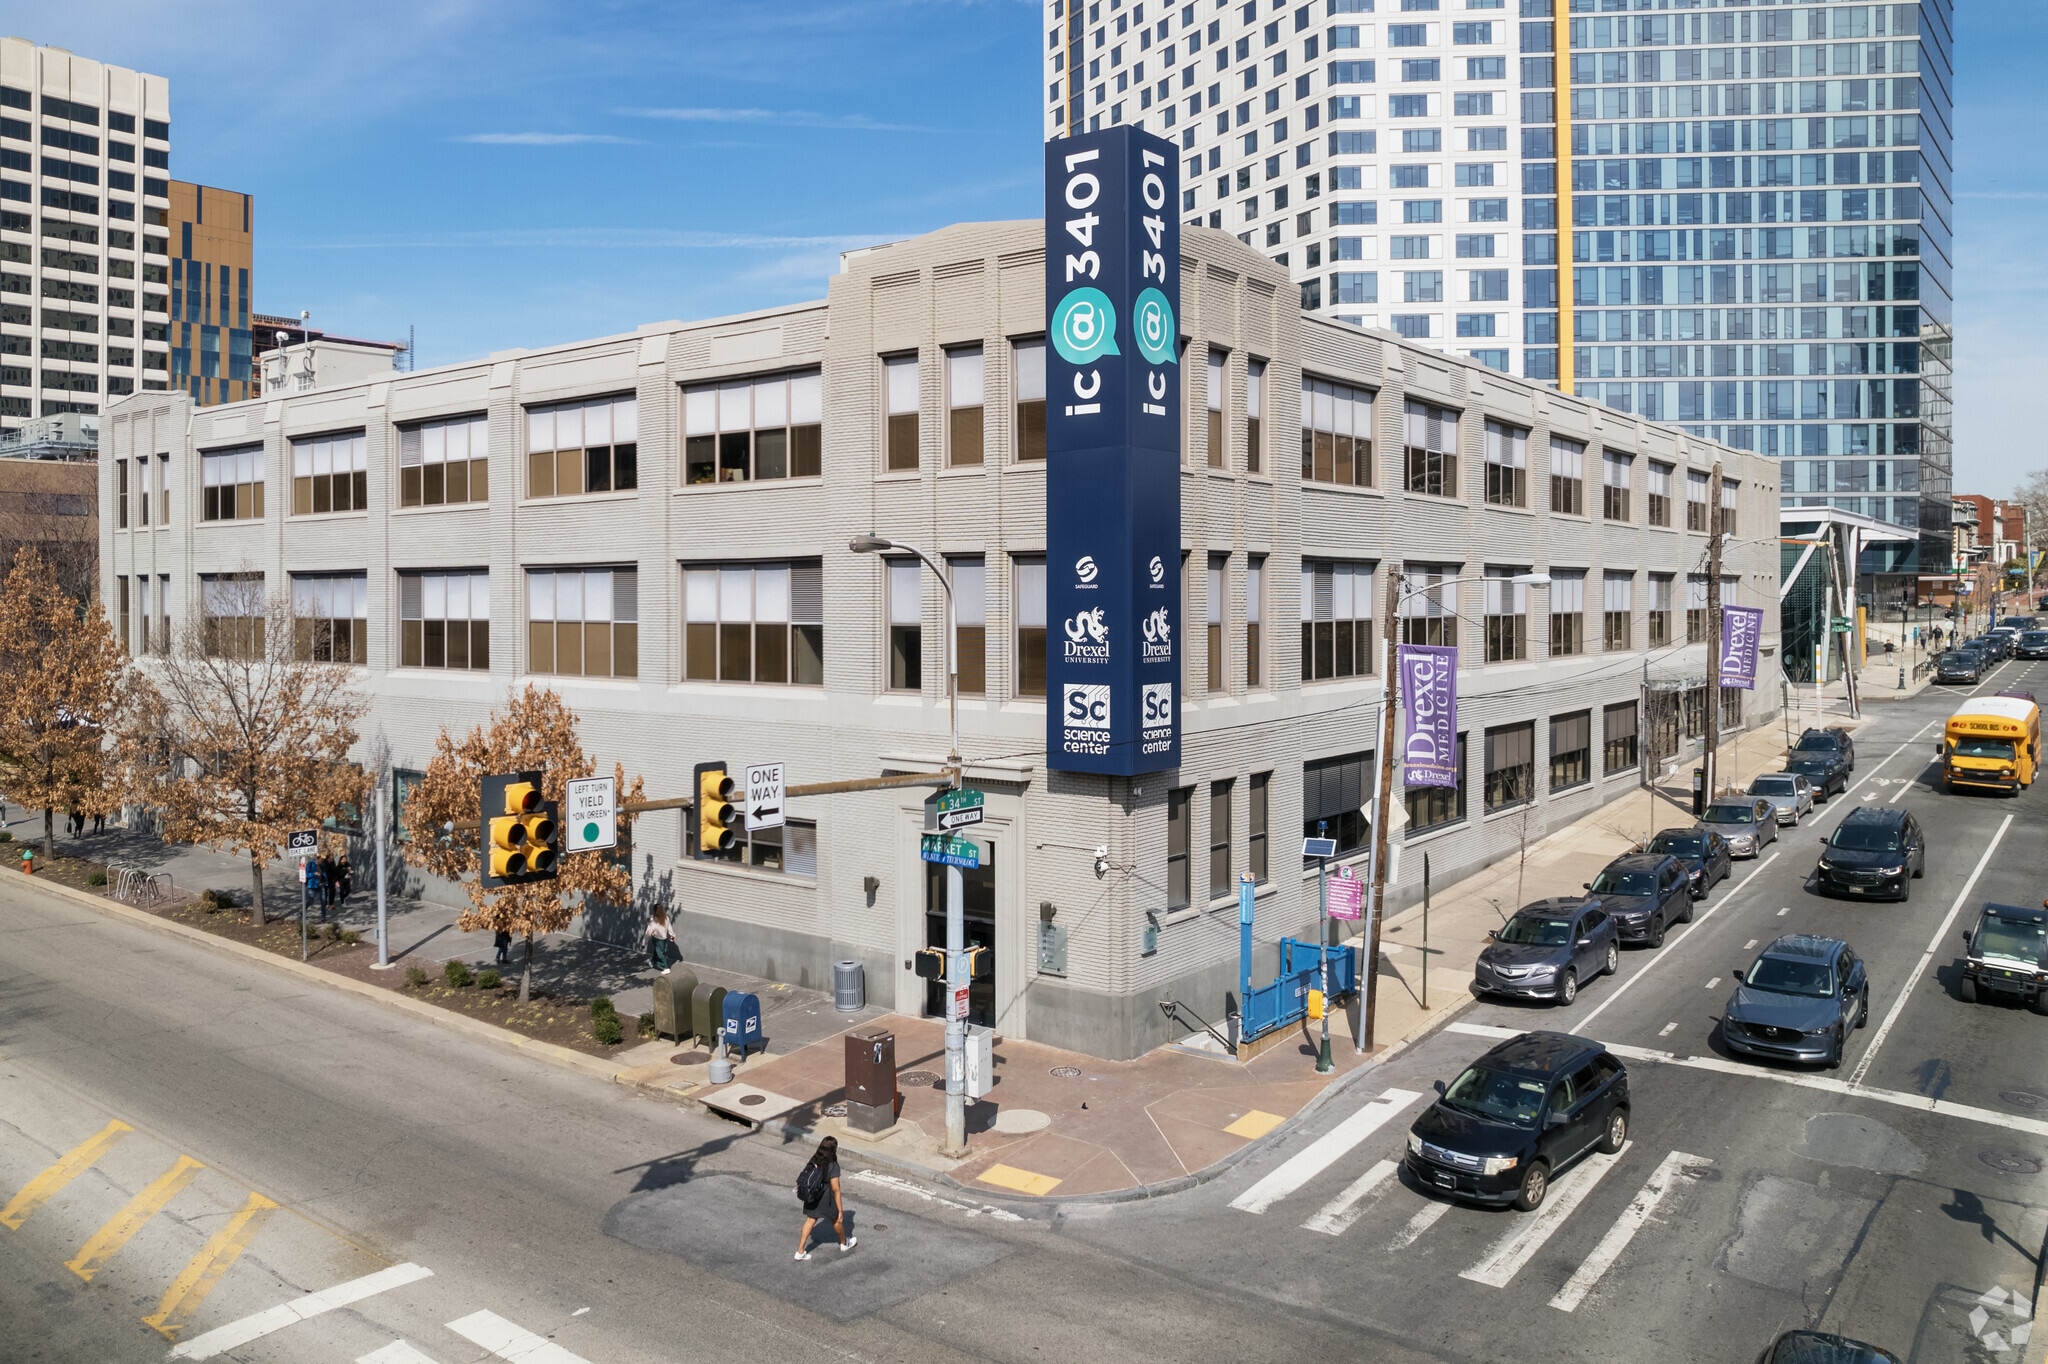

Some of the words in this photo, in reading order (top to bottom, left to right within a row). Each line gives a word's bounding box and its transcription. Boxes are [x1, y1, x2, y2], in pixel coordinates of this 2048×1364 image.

[1063, 640, 1110, 657] Drexel
[1142, 639, 1171, 657] Drexel
[1722, 610, 1748, 675] Drexel
[1742, 612, 1758, 674] MEDICINE
[1065, 656, 1109, 664] UNIVERSITY
[1143, 656, 1171, 664] UNIVERSITY
[1068, 691, 1106, 721] Sc
[1145, 691, 1169, 721] Sc
[1404, 653, 1436, 763] Drexel
[1436, 655, 1450, 762] MEDICINE
[1970, 722, 1988, 730] SCHOOL
[1064, 729, 1110, 743] science
[1142, 728, 1171, 742] science
[1064, 741, 1110, 755] center
[1142, 739, 1171, 755] center
[751, 766, 779, 784] ONE
[1424, 770, 1451, 781] Drexel
[575, 784, 589, 794] LEFT
[591, 783, 608, 792] TURN
[751, 785, 779, 802] WAY
[579, 795, 604, 807] YIELD
[974, 797, 982, 806] ST
[951, 814, 964, 823] ONE
[965, 812, 978, 820] WAY
[303, 846, 316, 854] LANE
[922, 841, 961, 855] MARKET
[968, 849, 977, 858] ST
